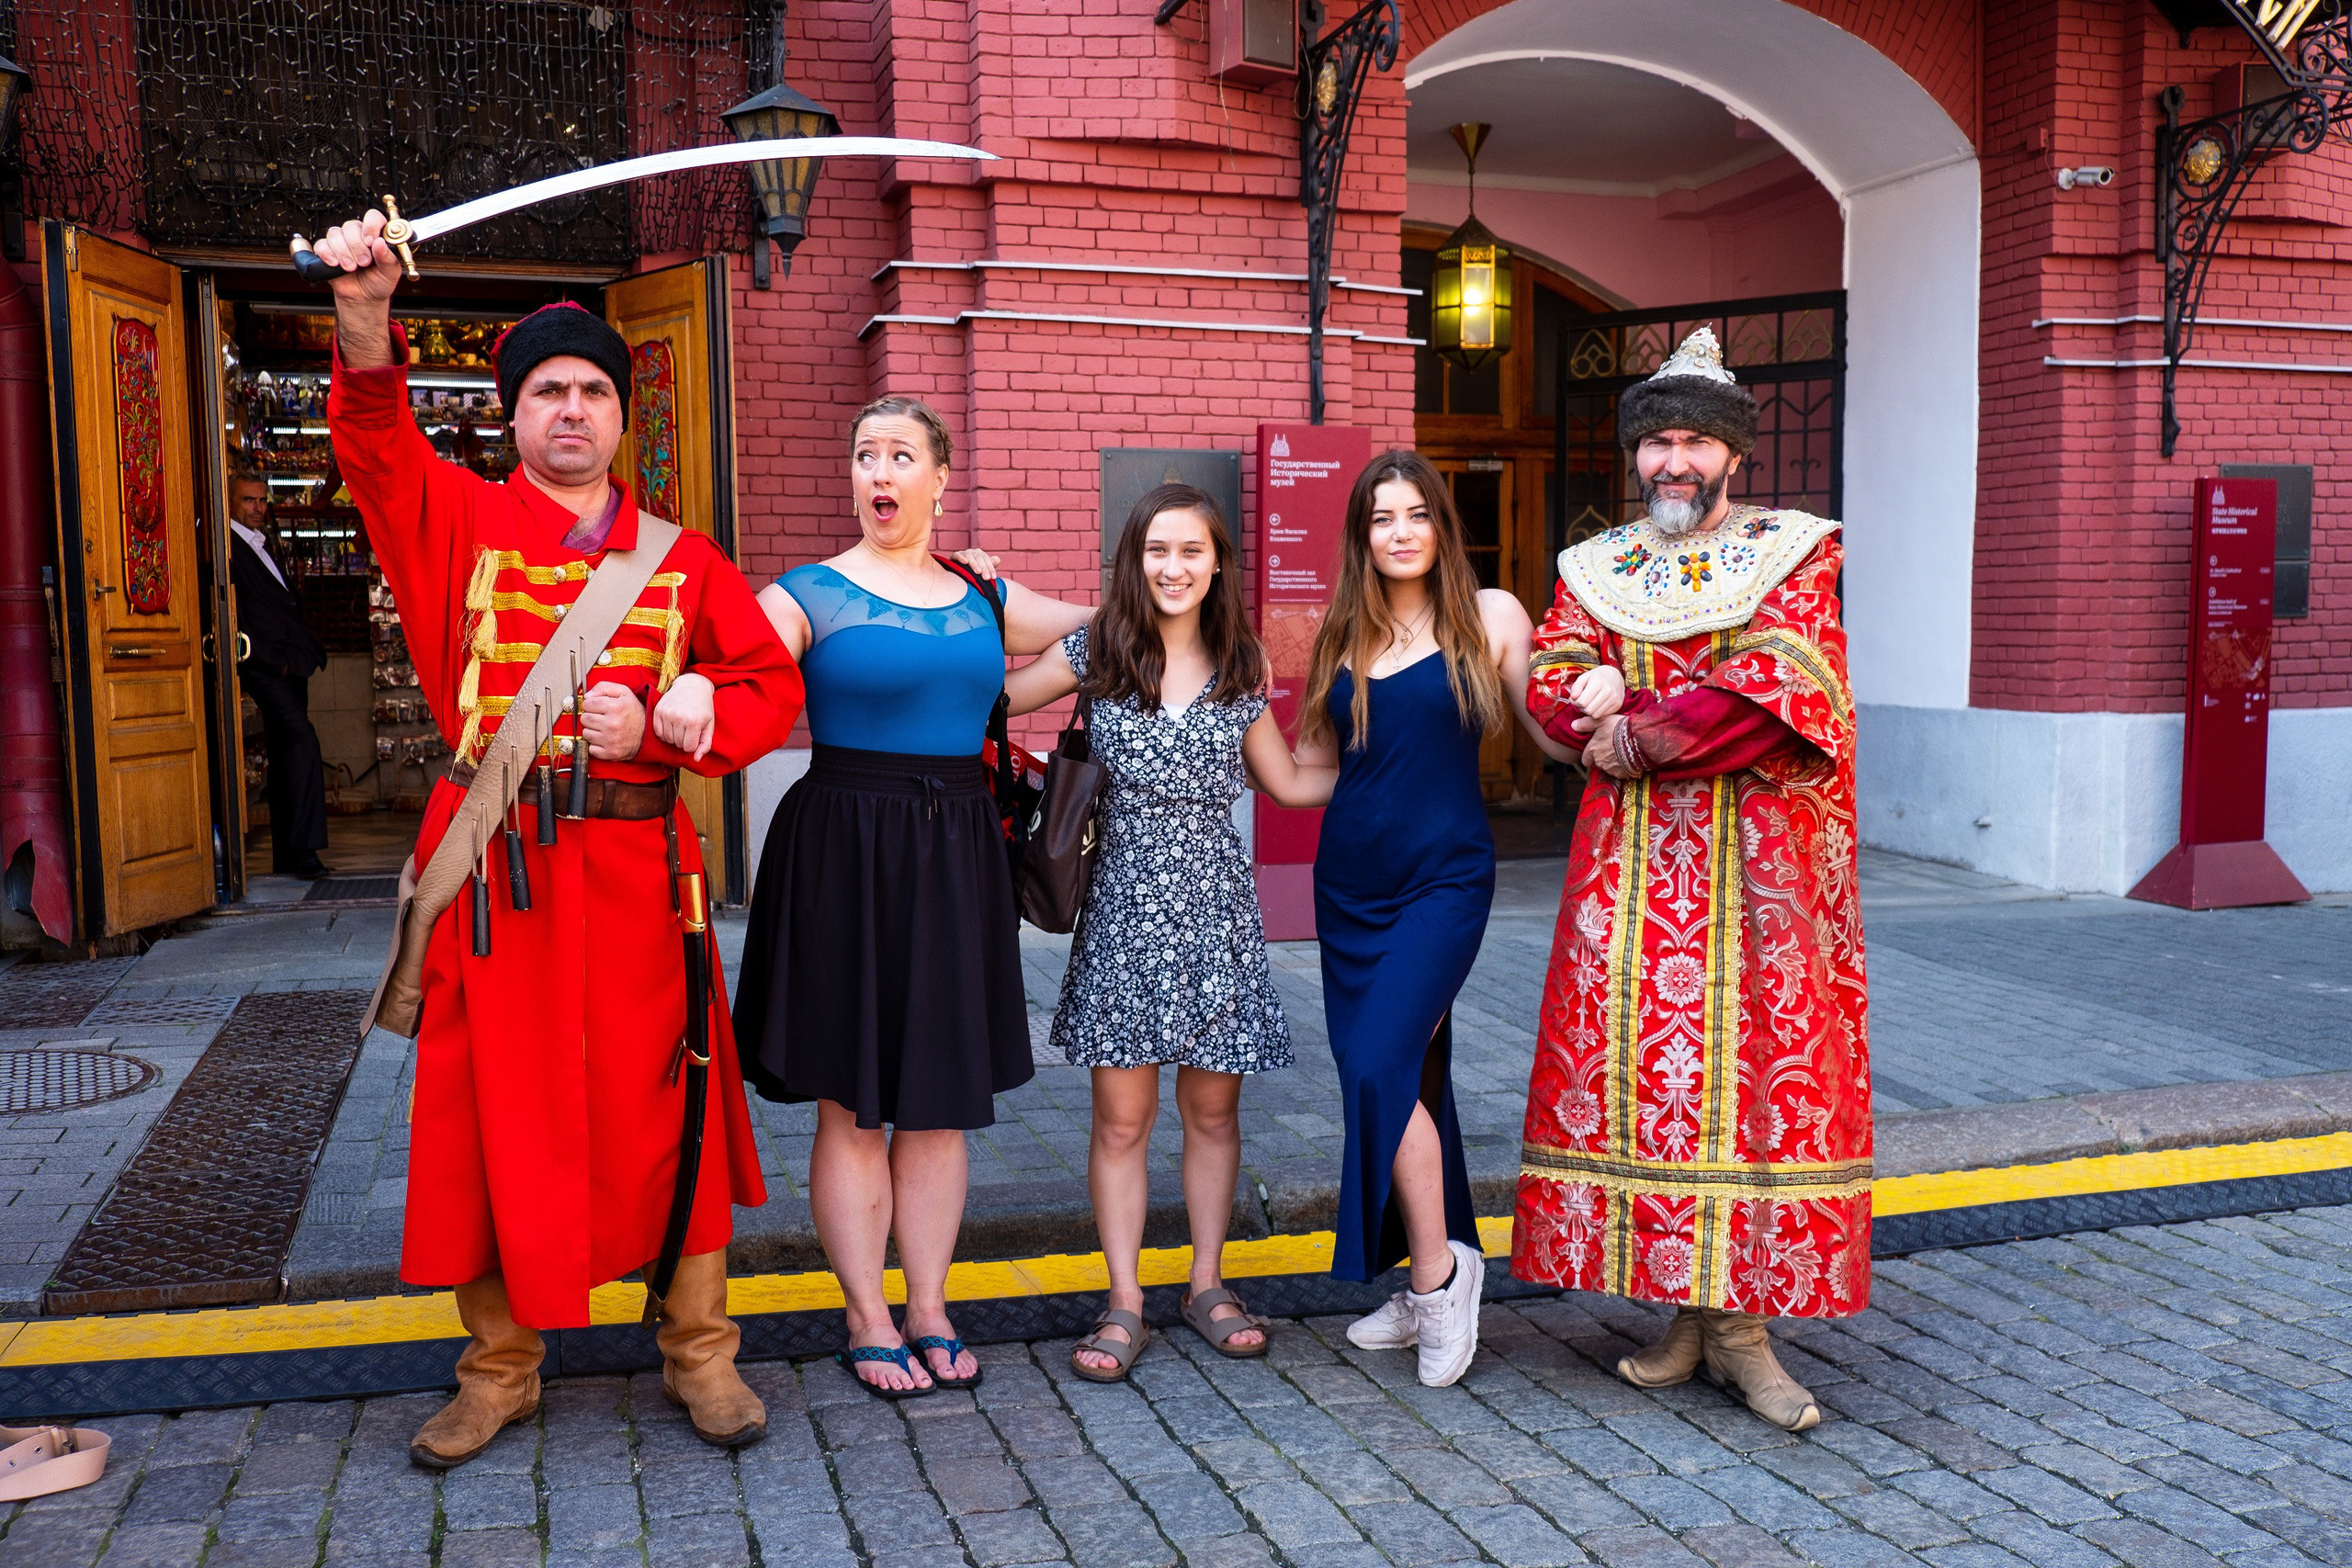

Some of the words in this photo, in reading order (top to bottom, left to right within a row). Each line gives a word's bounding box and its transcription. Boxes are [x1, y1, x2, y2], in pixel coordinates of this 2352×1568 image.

[1270, 459, 1340, 469] Государственный
[1270, 468, 1329, 479] Исторический
[1270, 479, 1295, 488] музей
